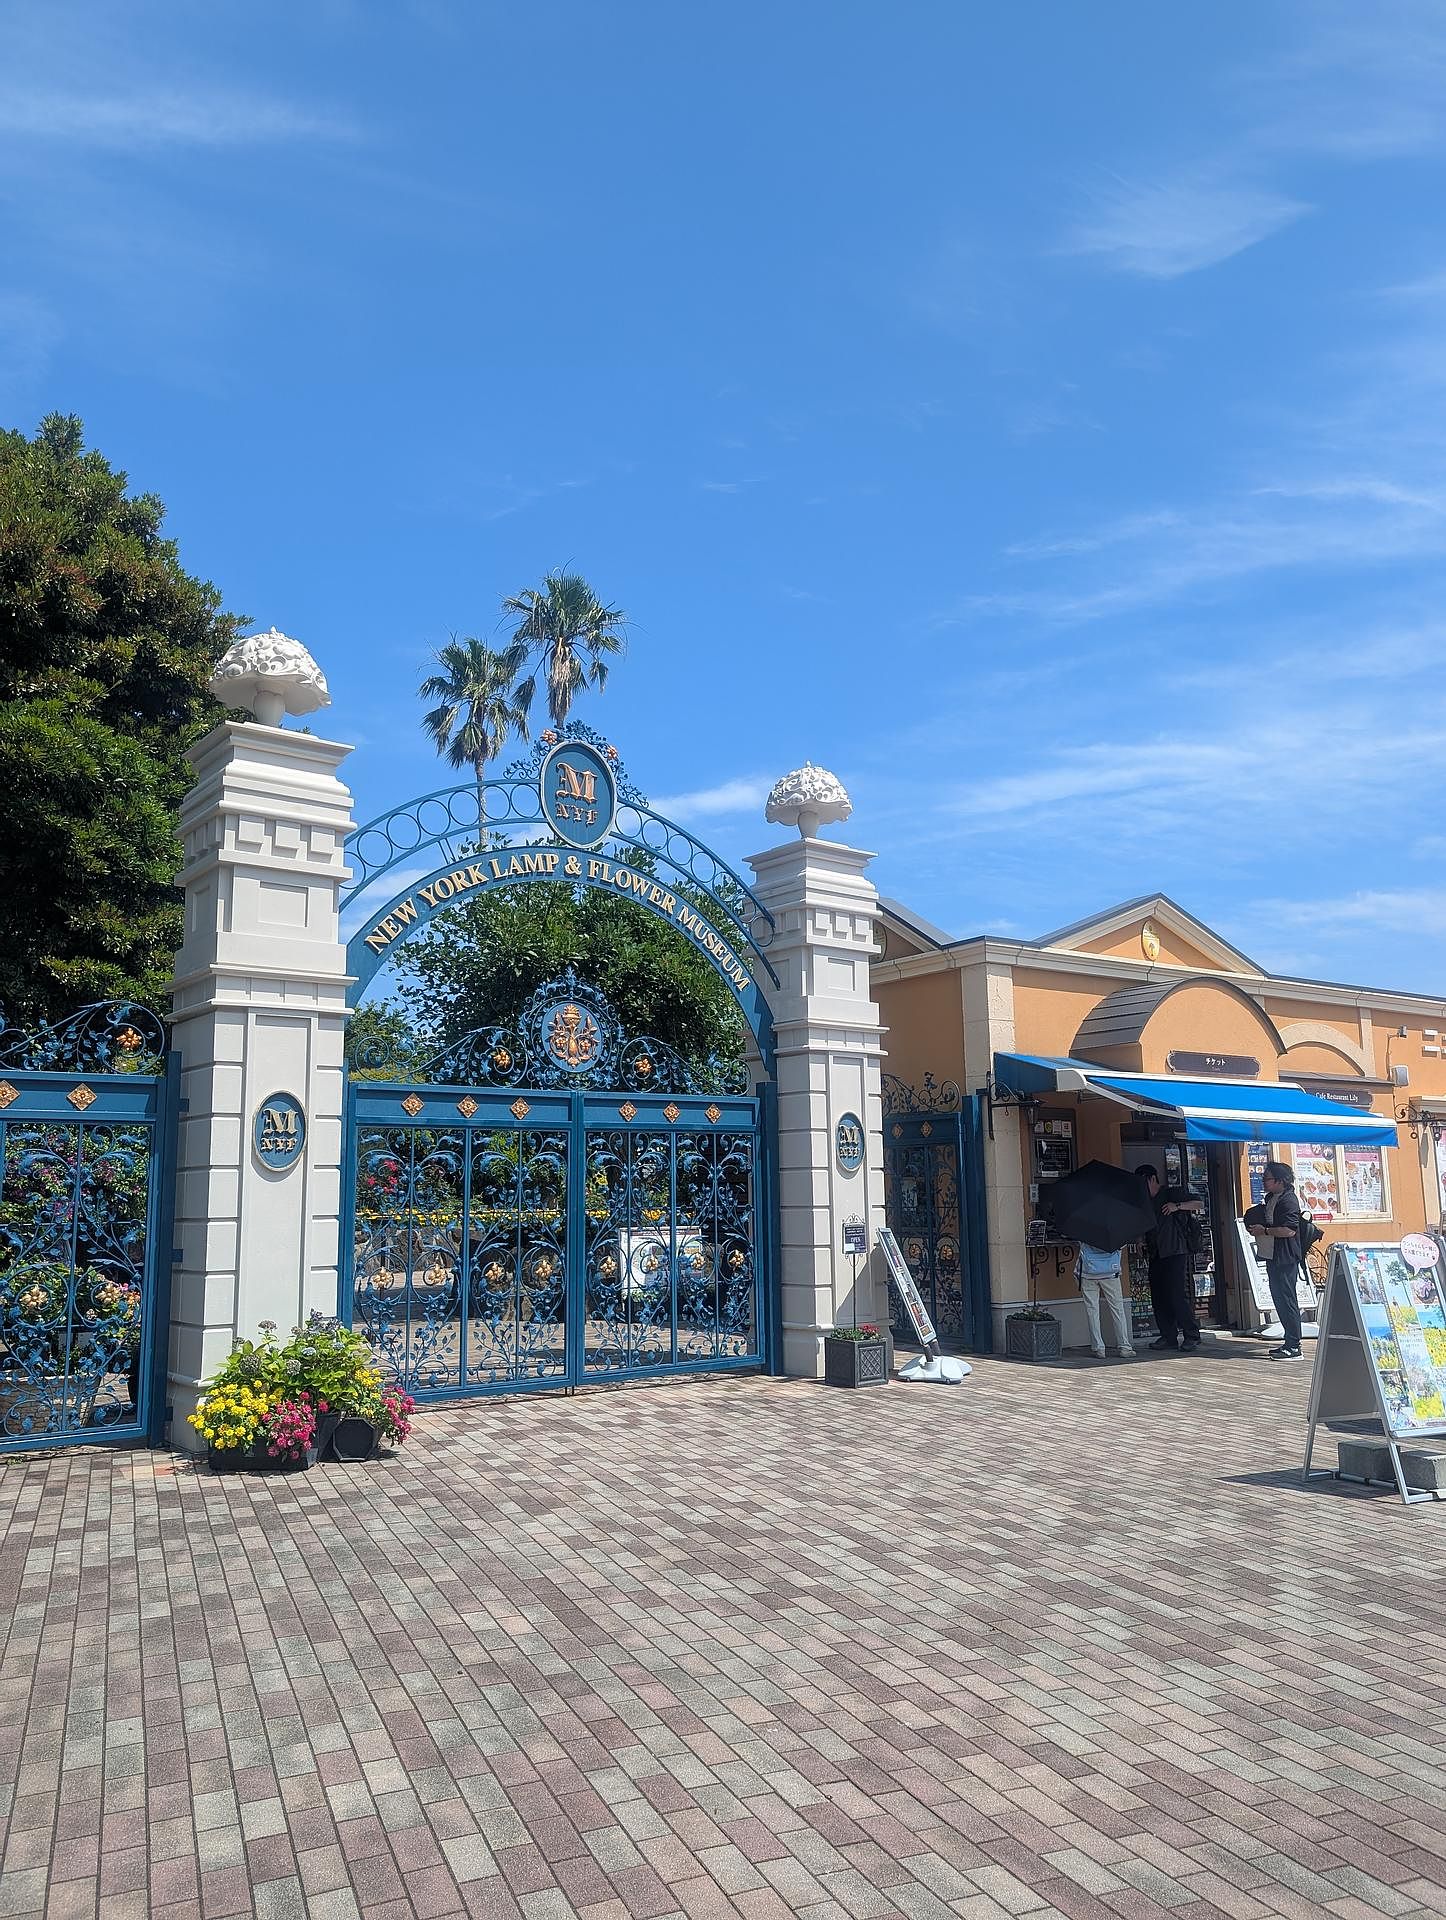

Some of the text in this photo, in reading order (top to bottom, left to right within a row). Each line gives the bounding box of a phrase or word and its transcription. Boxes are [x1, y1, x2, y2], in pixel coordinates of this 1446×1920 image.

[556, 762, 598, 804] M
[364, 853, 751, 992] NEW YORK LAMP & FLOWER MUSEUM
[1205, 1057, 1226, 1066] チケット
[1326, 1093, 1349, 1101] Restaurant
[1349, 1094, 1359, 1102] Lily
[263, 1108, 299, 1134] M
[839, 1124, 860, 1144] M
